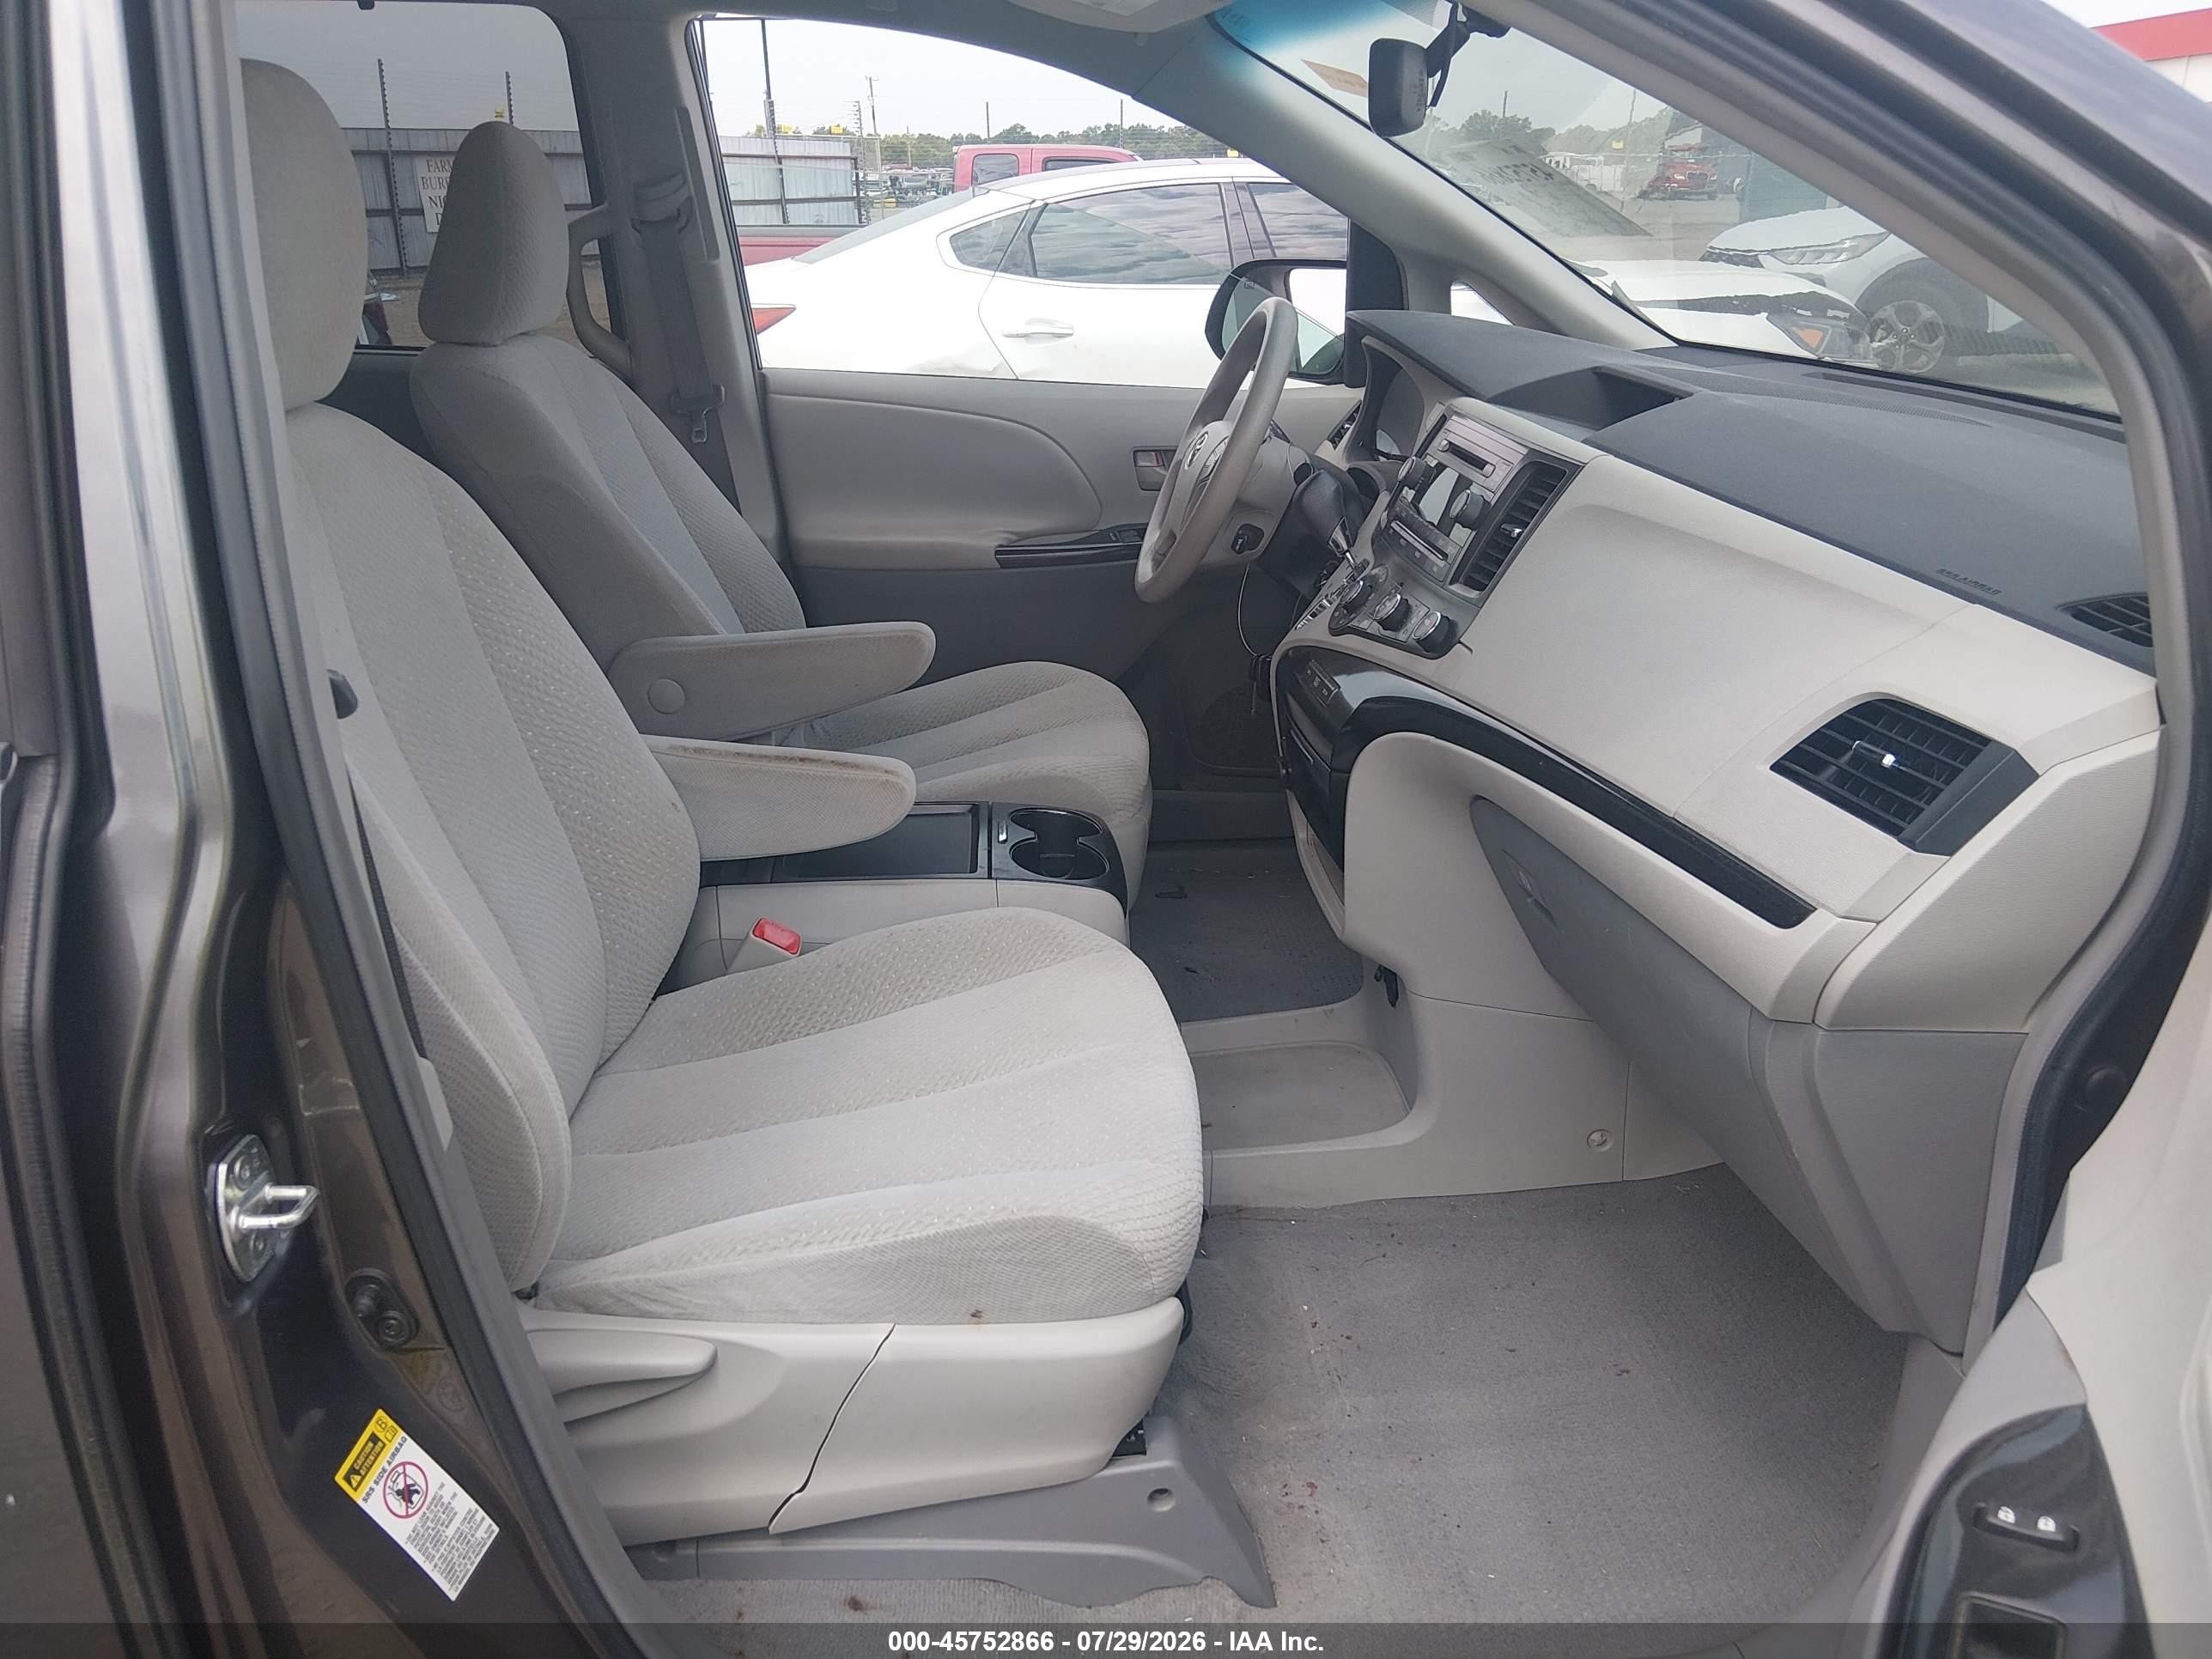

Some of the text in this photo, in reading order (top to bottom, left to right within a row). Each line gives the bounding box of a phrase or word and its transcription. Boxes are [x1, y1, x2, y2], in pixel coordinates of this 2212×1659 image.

[353, 1441, 374, 1471] CAUTION
[359, 1440, 385, 1477] ATTENTION
[362, 1436, 408, 1504] SRS SIDE AIRBAG
